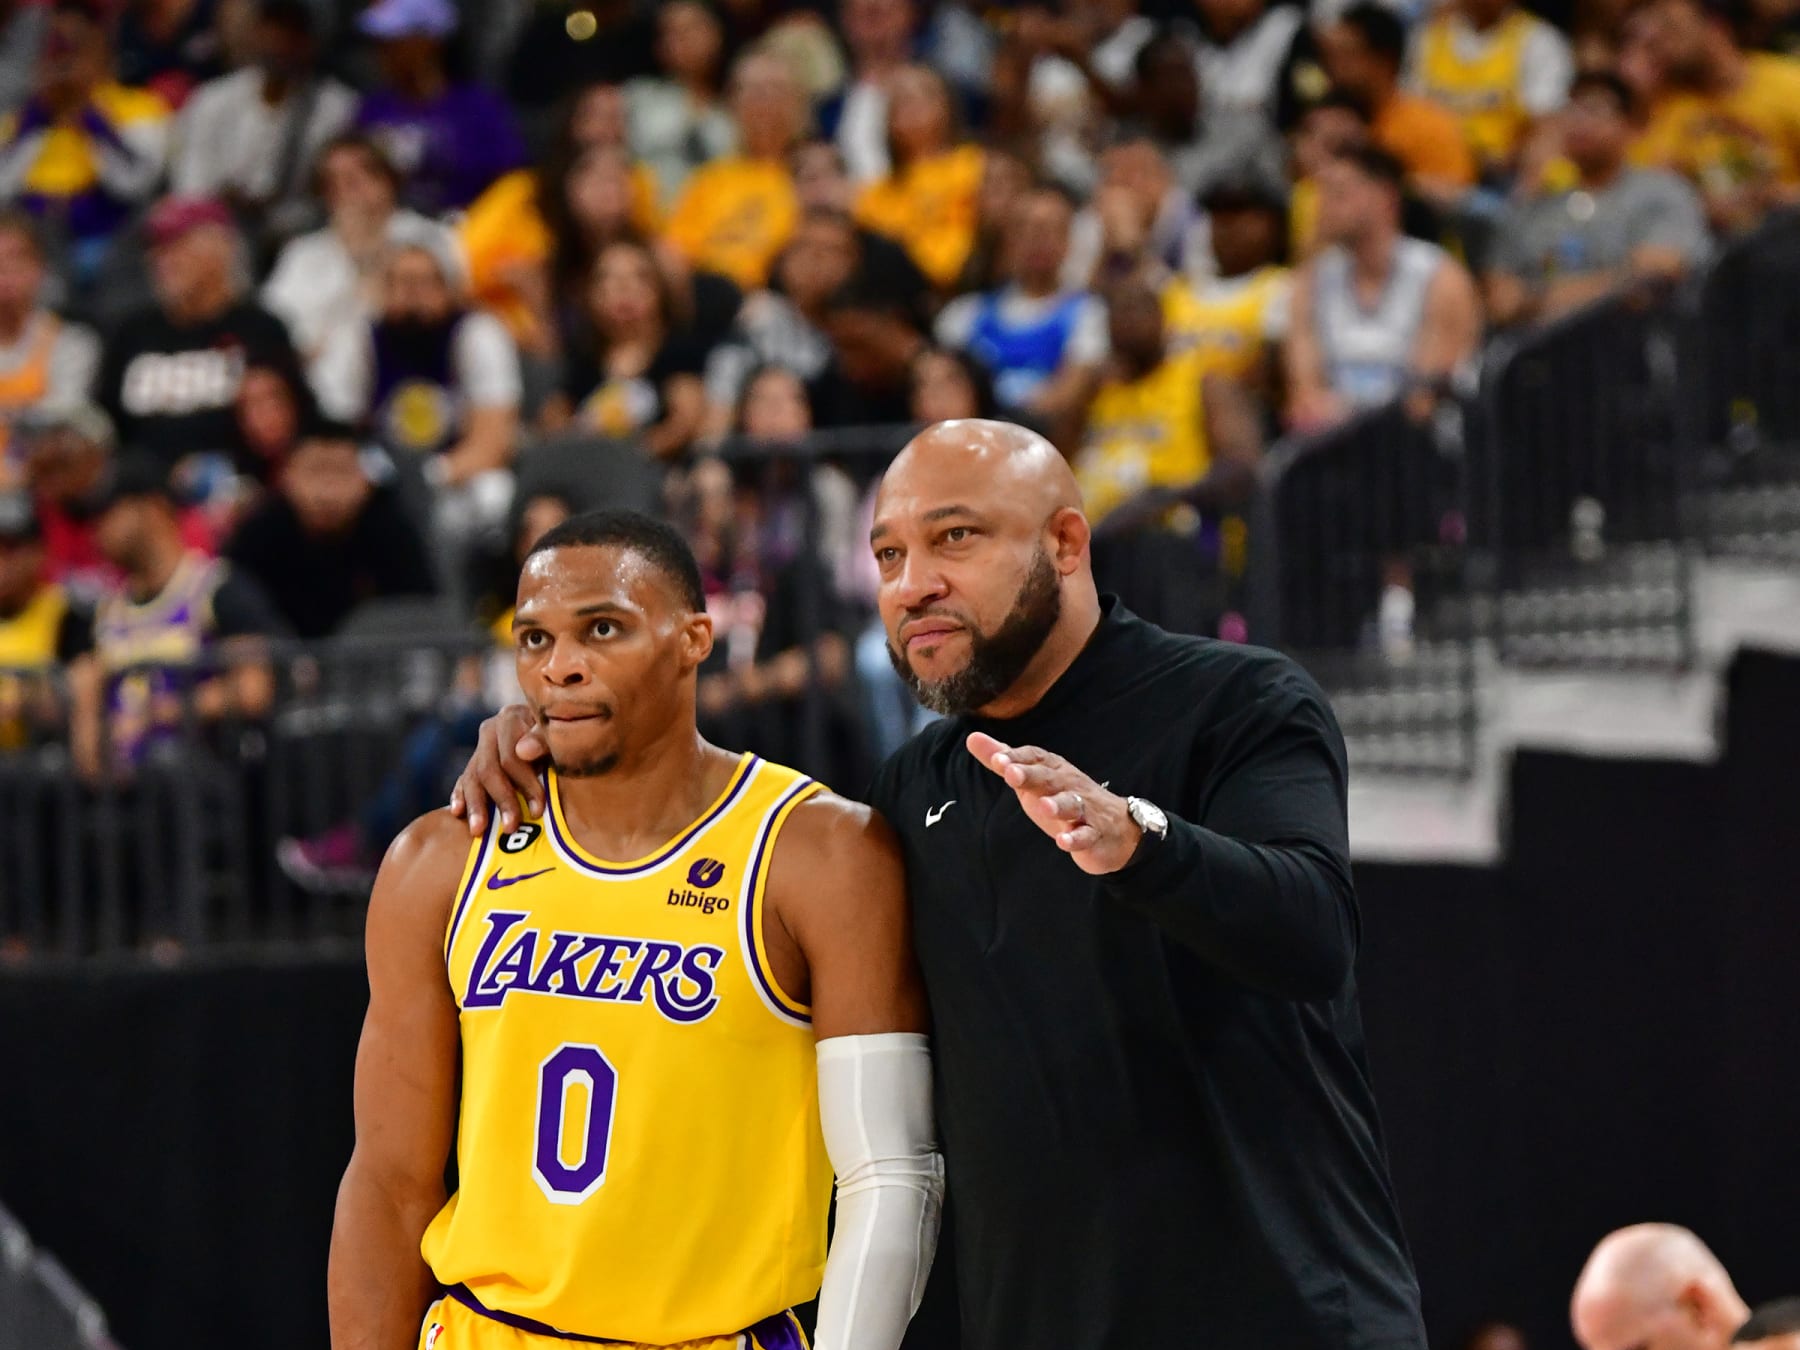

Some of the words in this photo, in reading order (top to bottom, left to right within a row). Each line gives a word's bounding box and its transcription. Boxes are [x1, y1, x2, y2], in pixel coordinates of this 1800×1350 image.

[505, 825, 534, 851] 6
[667, 888, 730, 914] bibigo
[461, 909, 728, 1024] LAKERS
[532, 1041, 618, 1205] 0
